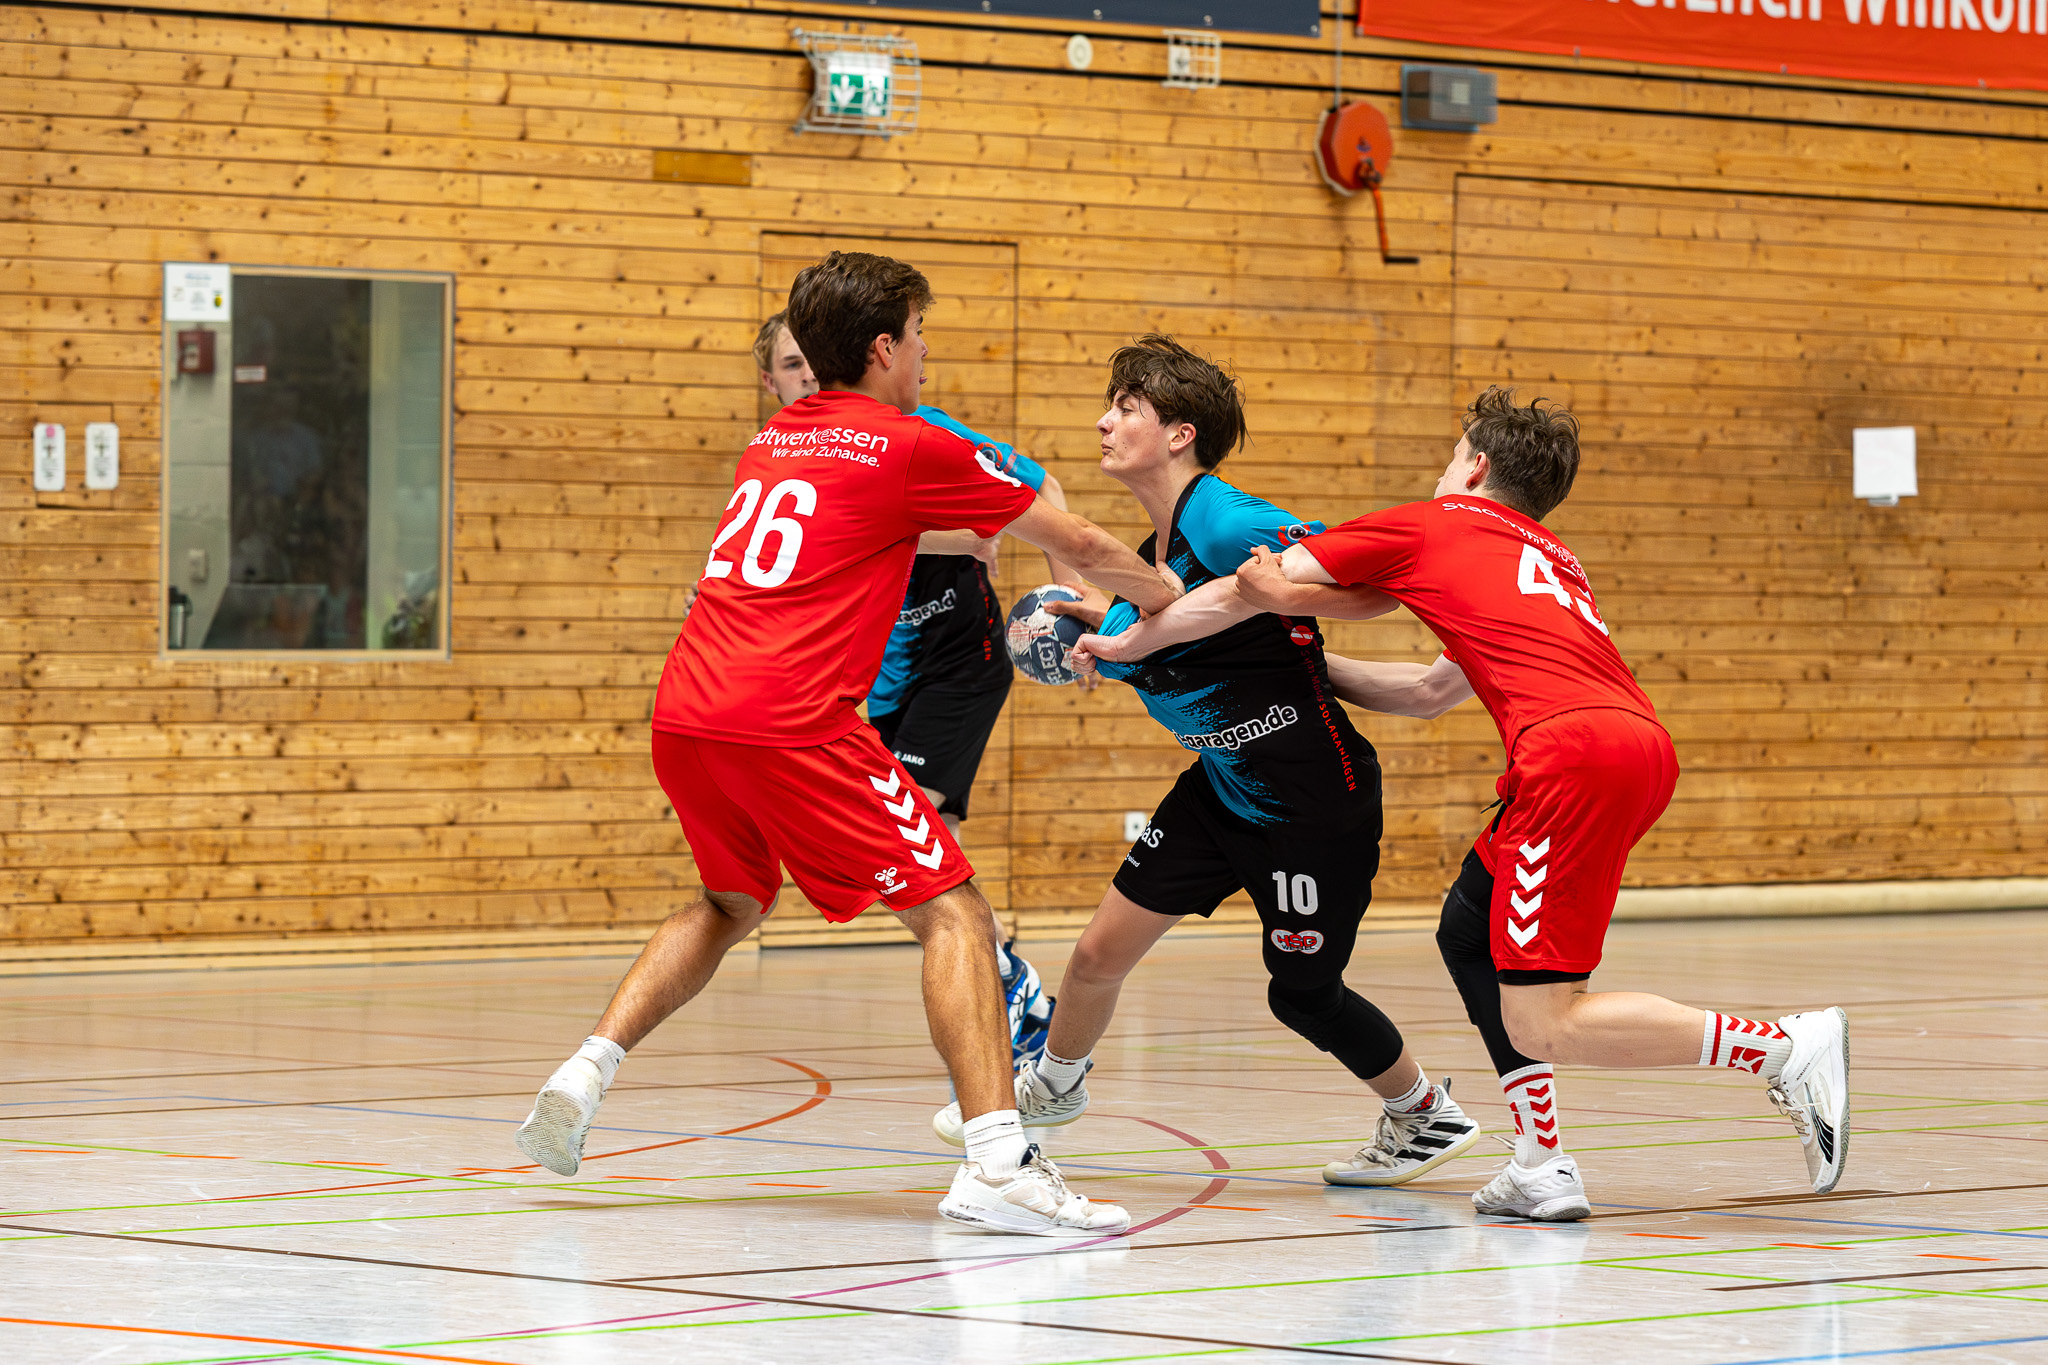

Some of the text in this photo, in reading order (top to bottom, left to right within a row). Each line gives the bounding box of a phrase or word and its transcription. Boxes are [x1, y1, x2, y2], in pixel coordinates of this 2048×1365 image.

[749, 426, 890, 453] adtwerkessen
[771, 446, 881, 468] Wir sind Zuhause.
[701, 478, 818, 589] 26
[1172, 705, 1299, 750] -garagen.de
[900, 753, 926, 766] JAKO
[1319, 703, 1357, 791] SOLARANLAGEN
[1272, 870, 1319, 916] 10
[1276, 934, 1318, 949] HSG
